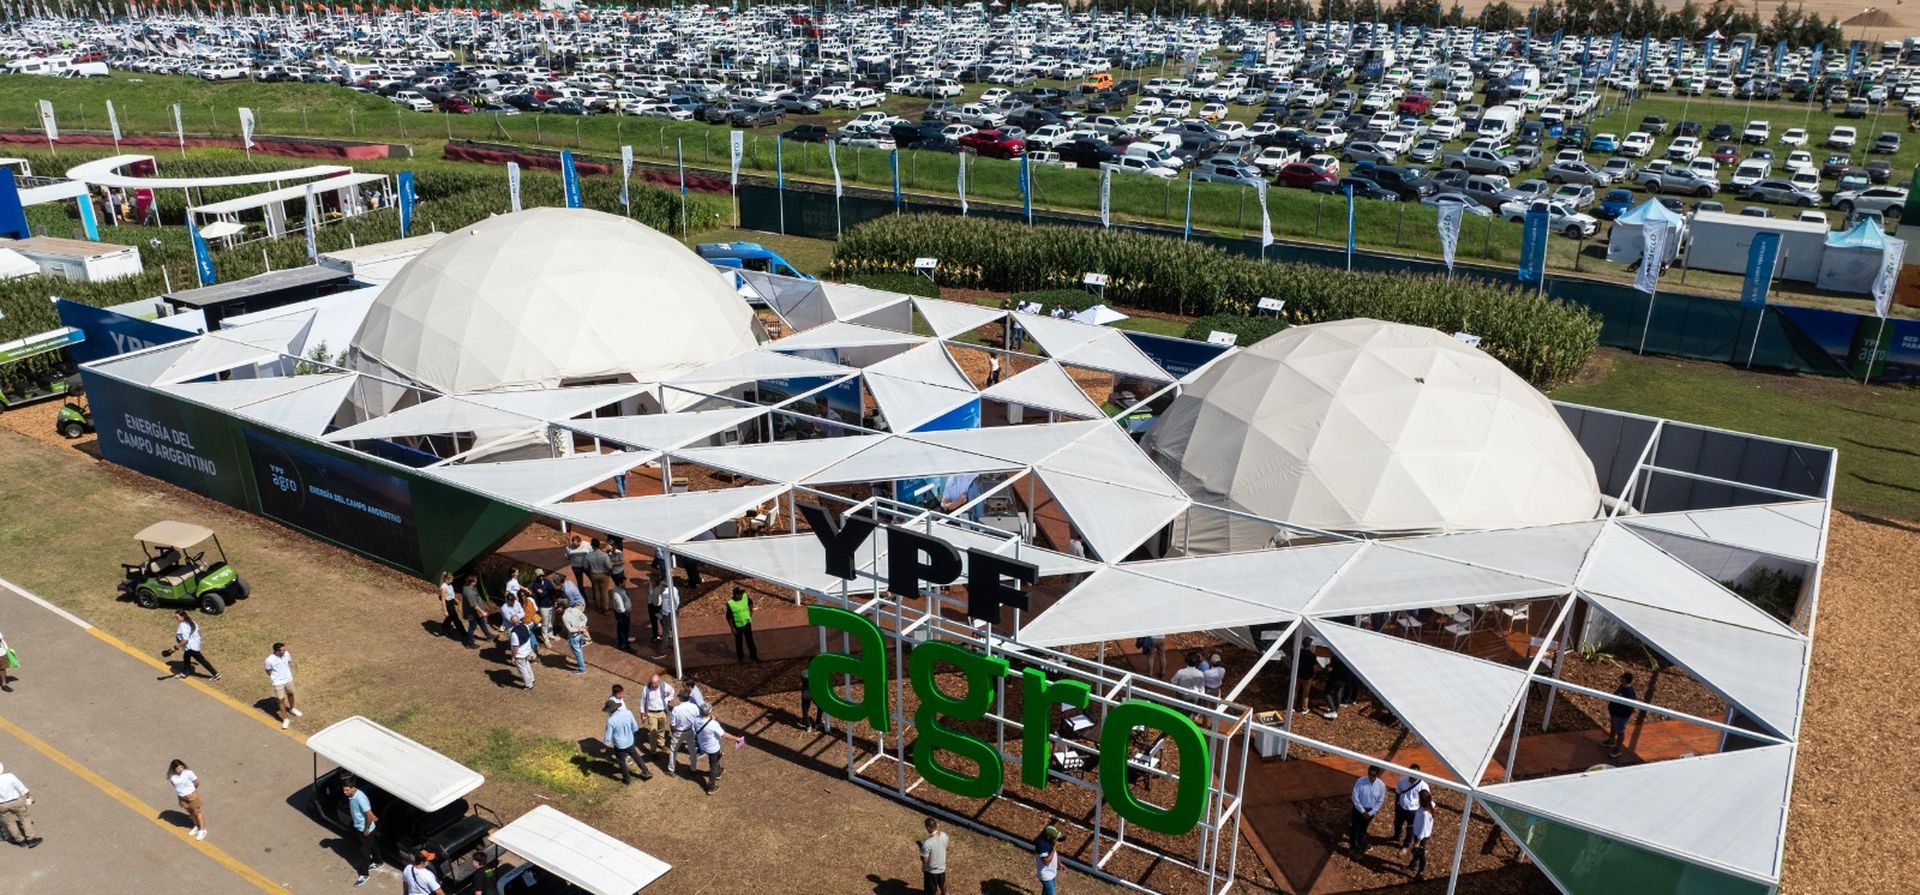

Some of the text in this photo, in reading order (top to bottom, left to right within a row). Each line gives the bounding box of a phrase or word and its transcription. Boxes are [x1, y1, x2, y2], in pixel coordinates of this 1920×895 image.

[124, 413, 194, 449] ENERGÍA DEL
[117, 429, 216, 476] CAMPO ARGENTINO
[269, 463, 285, 474] YPF
[272, 473, 297, 492] agro
[334, 494, 346, 505] DEL
[346, 497, 367, 512] CAMPO
[367, 506, 402, 524] ARGENTINO
[797, 503, 1039, 624] YPF
[807, 605, 1210, 835] agro
